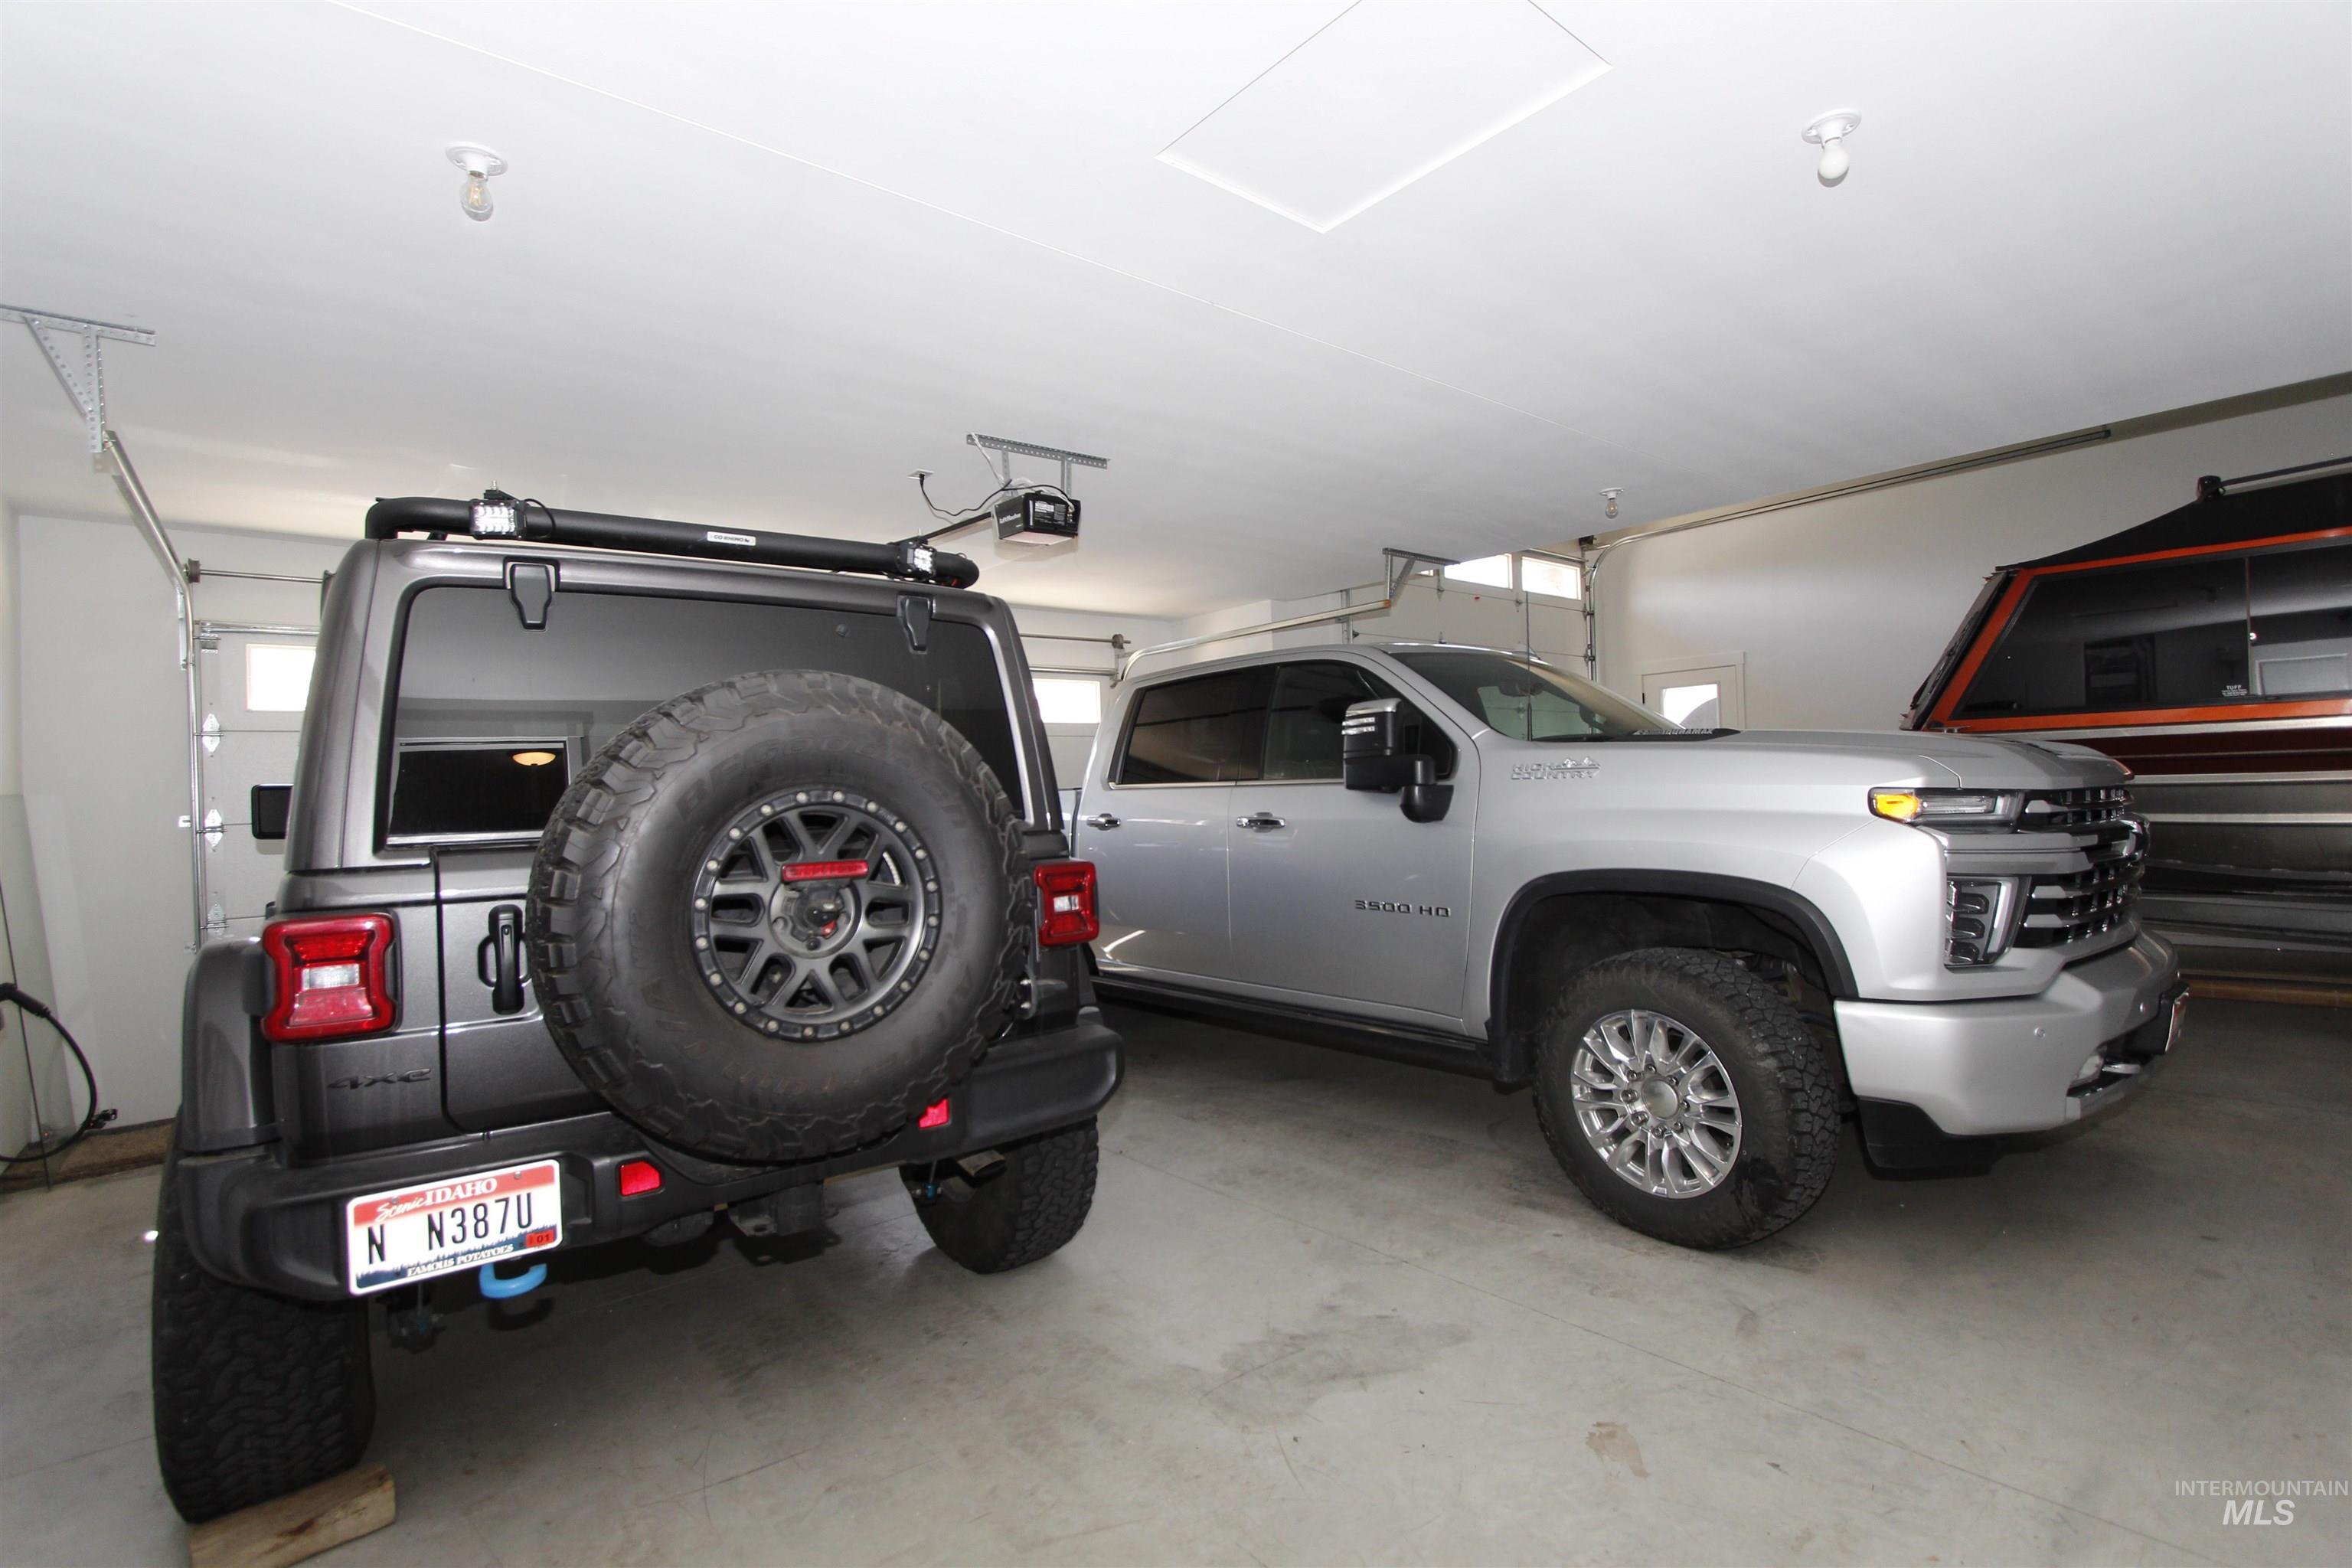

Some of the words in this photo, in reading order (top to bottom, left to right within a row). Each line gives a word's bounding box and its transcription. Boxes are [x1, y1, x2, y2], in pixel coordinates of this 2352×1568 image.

[1511, 770, 1593, 779] COUNTRY
[1354, 900, 1412, 913] 3500
[1419, 905, 1451, 917] HD
[375, 1197, 427, 1223] Scenic
[424, 1178, 498, 1206] IDAHO
[368, 1224, 385, 1265] N
[428, 1192, 534, 1251] N387U
[536, 1233, 550, 1243] 01
[407, 1257, 455, 1277] FAMOUS
[456, 1243, 514, 1265] POTATOES
